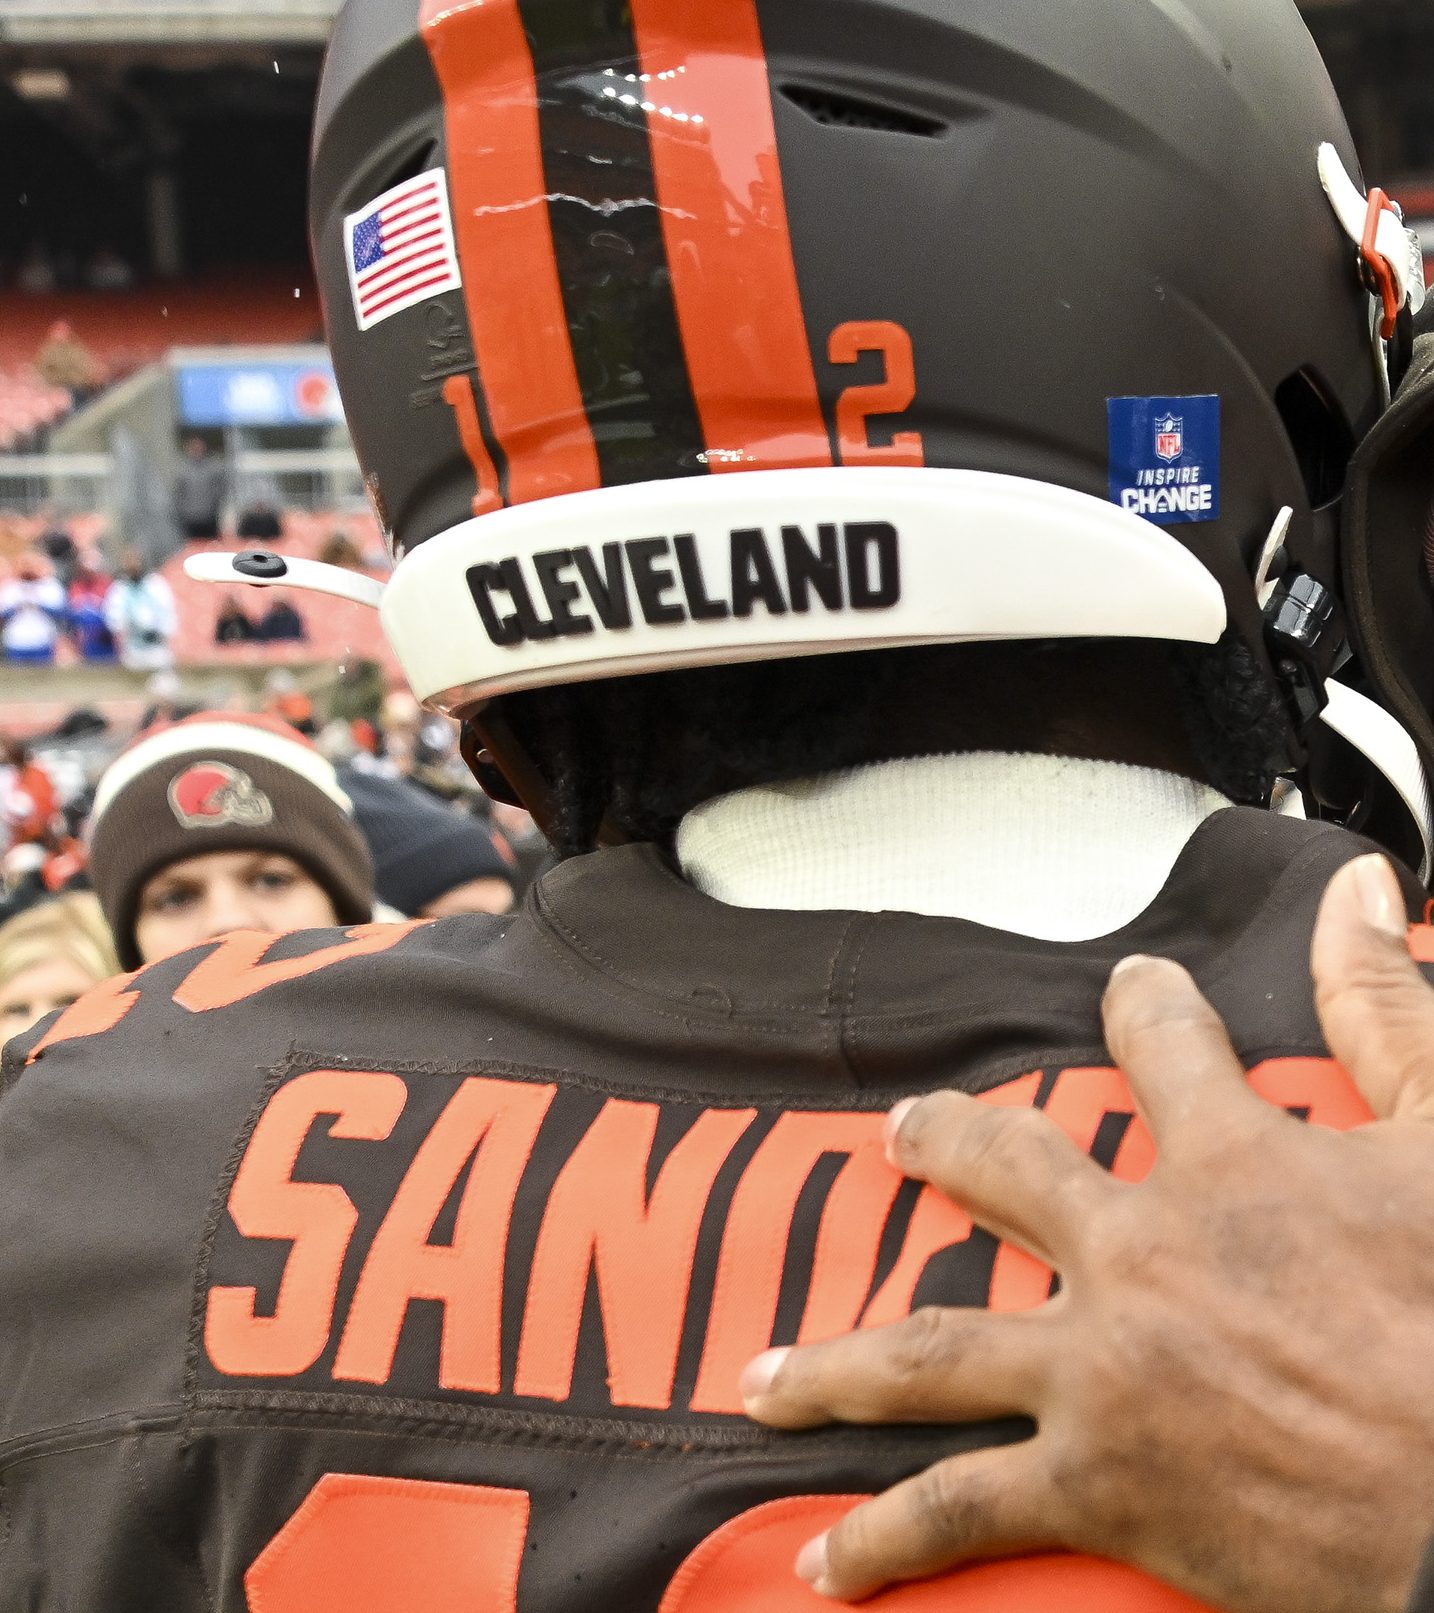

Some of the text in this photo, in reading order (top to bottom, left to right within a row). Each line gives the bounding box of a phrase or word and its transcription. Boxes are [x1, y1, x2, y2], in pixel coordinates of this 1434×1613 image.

[1157, 434, 1180, 456] NFL
[1137, 466, 1200, 486] INSPIRE
[1121, 484, 1212, 514] CHANGE
[465, 521, 900, 647] CLEVELAND
[203, 1056, 1379, 1415] SAND
